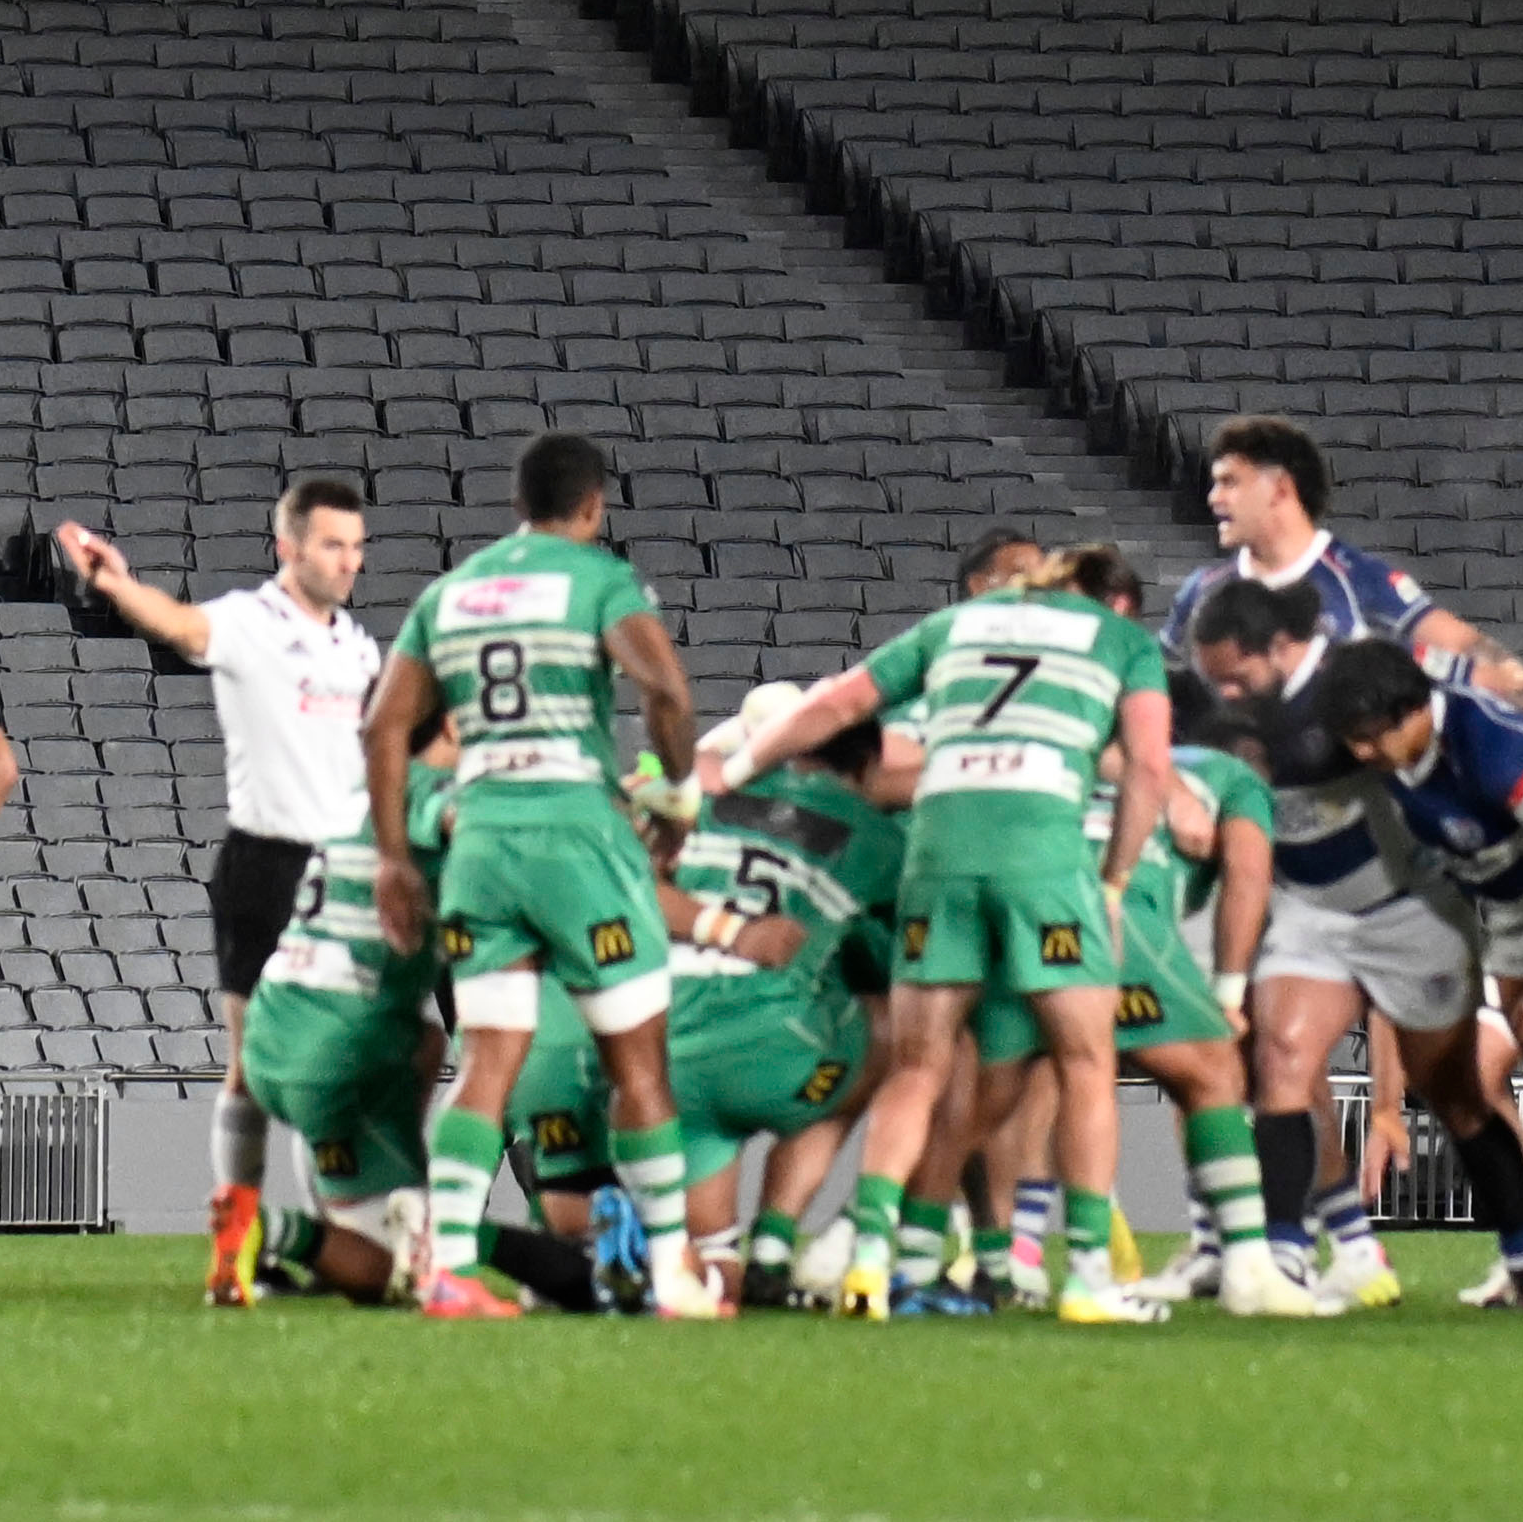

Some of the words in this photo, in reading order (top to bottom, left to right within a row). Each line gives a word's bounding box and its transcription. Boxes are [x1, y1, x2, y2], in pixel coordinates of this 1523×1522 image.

[480, 641, 528, 722] 8
[974, 653, 1040, 727] 7
[724, 847, 790, 921] 5
